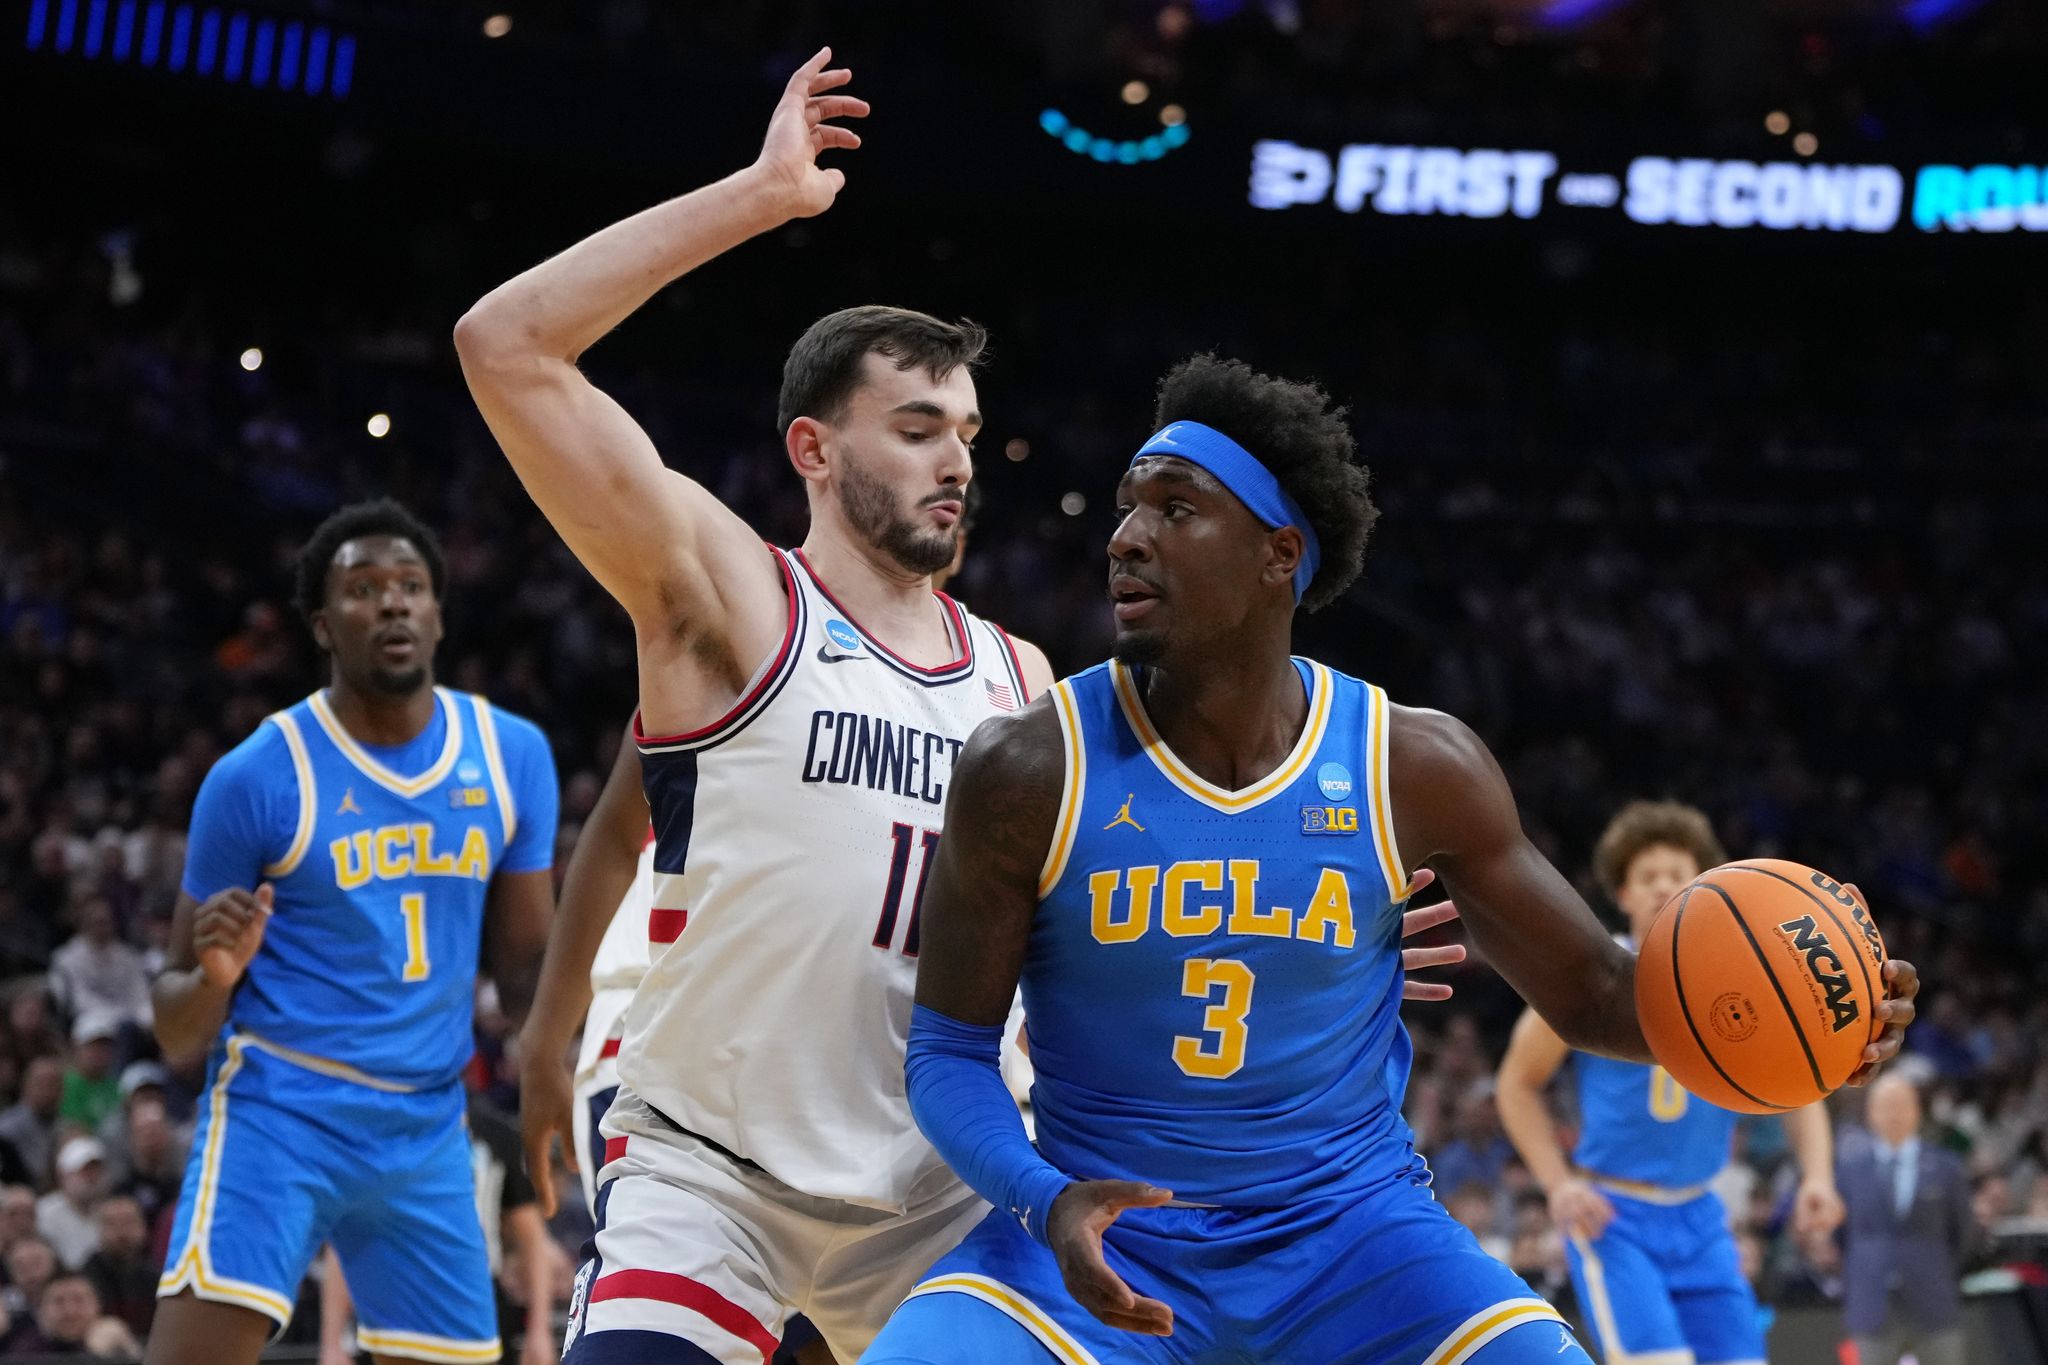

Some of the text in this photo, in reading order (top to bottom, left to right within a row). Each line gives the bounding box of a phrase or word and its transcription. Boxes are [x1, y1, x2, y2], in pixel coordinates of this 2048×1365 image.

[1334, 143, 1558, 218] FIRST
[1623, 156, 1903, 233] SECOND
[1322, 779, 1352, 792] NCAA
[329, 822, 492, 892] UCLA
[400, 892, 431, 983] 1
[1088, 859, 1357, 949] UCLA
[1778, 913, 1860, 1034] NCAA
[1171, 958, 1256, 1080] 3
